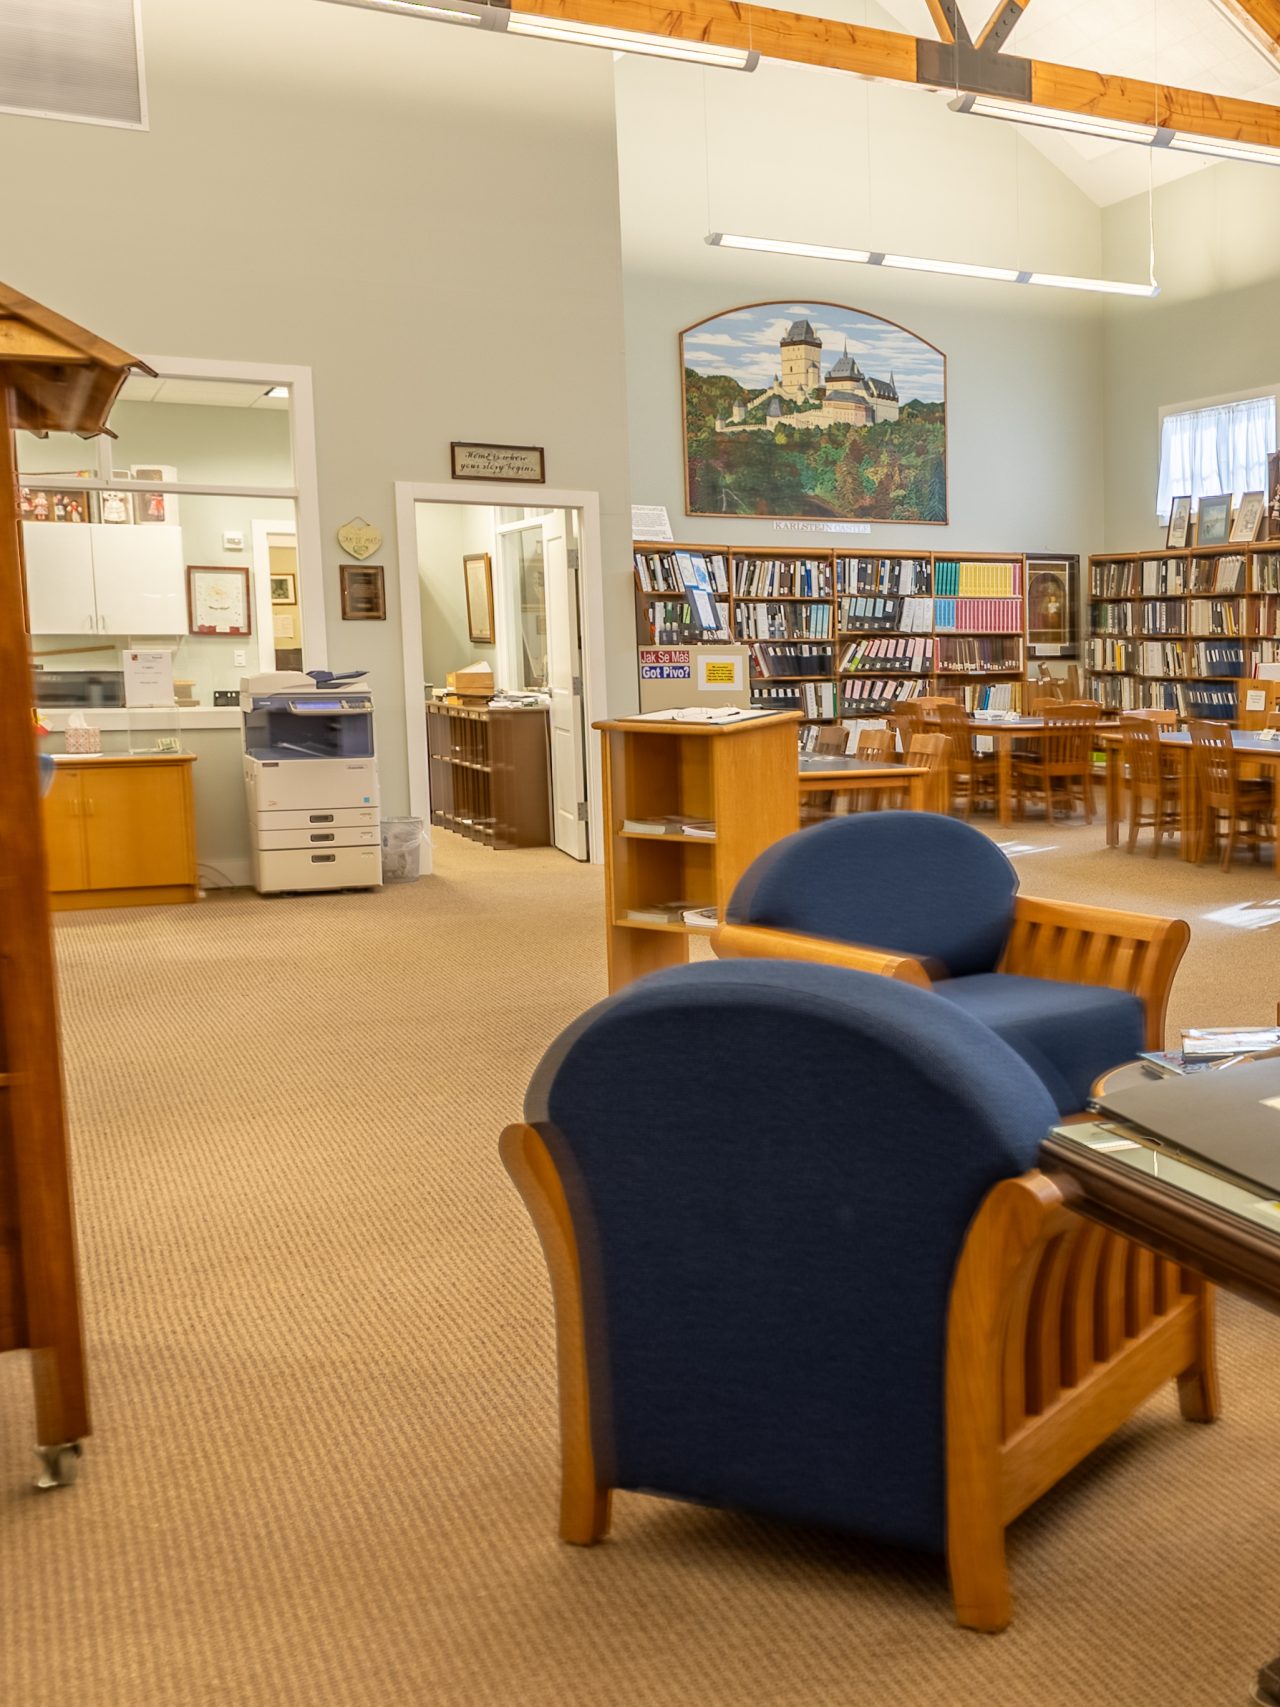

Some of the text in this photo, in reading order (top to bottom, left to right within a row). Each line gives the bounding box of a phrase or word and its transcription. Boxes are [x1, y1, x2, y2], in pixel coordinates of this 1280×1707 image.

[641, 651, 656, 663] Jak
[658, 651, 669, 663] Se
[642, 666, 690, 678] Got Pivo?
